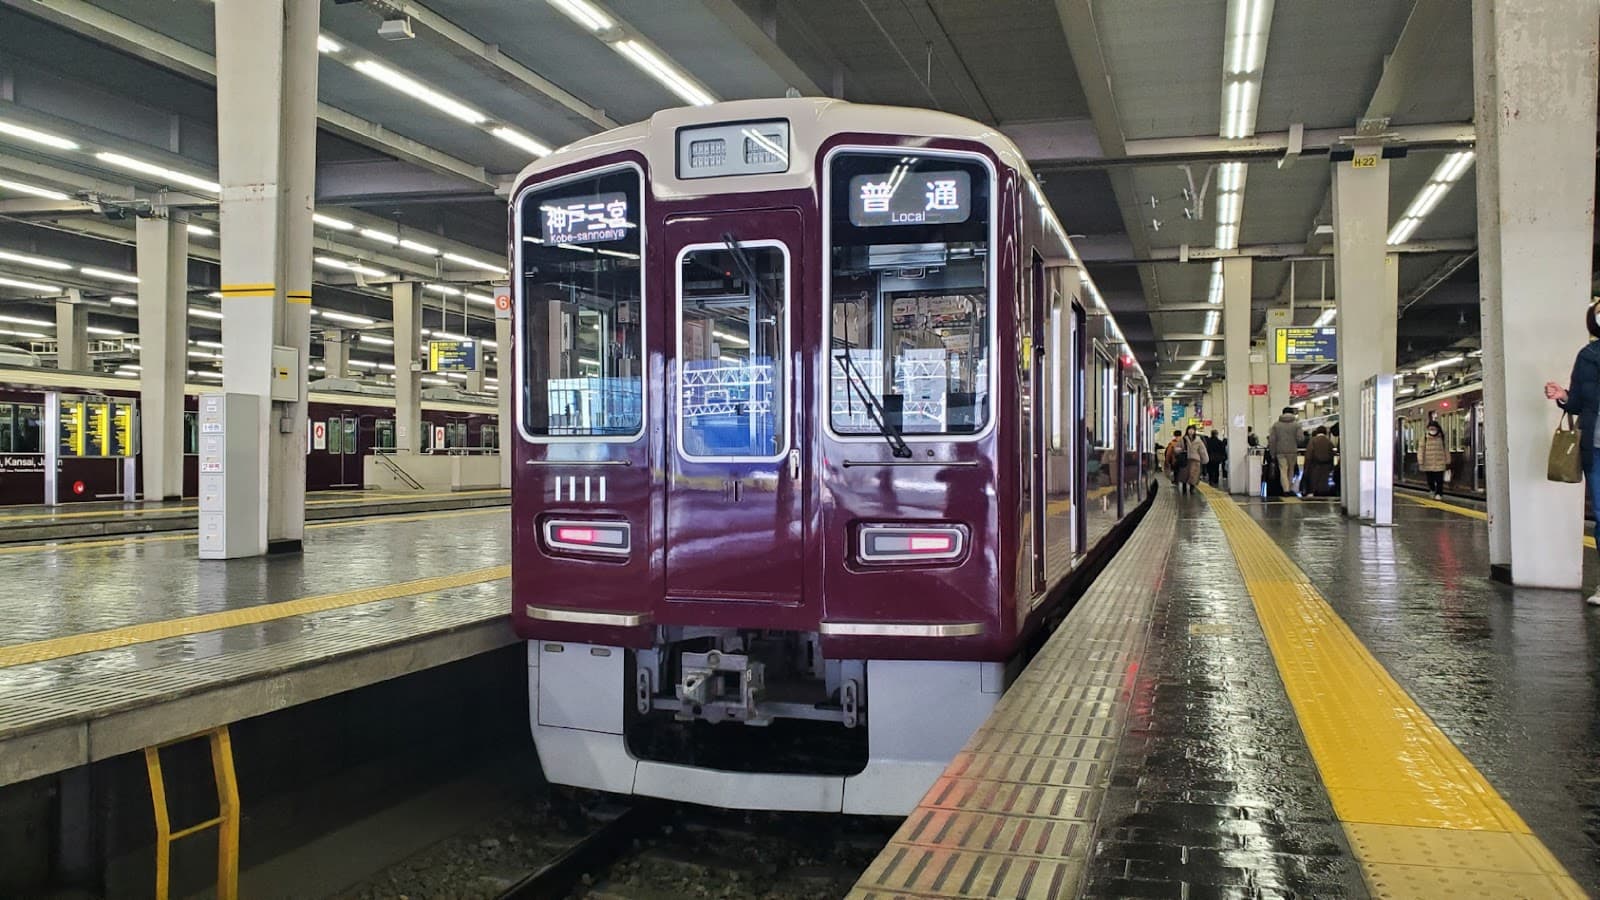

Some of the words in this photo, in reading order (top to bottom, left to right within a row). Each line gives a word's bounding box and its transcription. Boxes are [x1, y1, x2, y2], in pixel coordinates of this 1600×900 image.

[859, 180, 960, 213] 普通
[546, 199, 627, 235] 神戸三宮
[891, 210, 926, 223] Local
[555, 476, 606, 502] 1111
